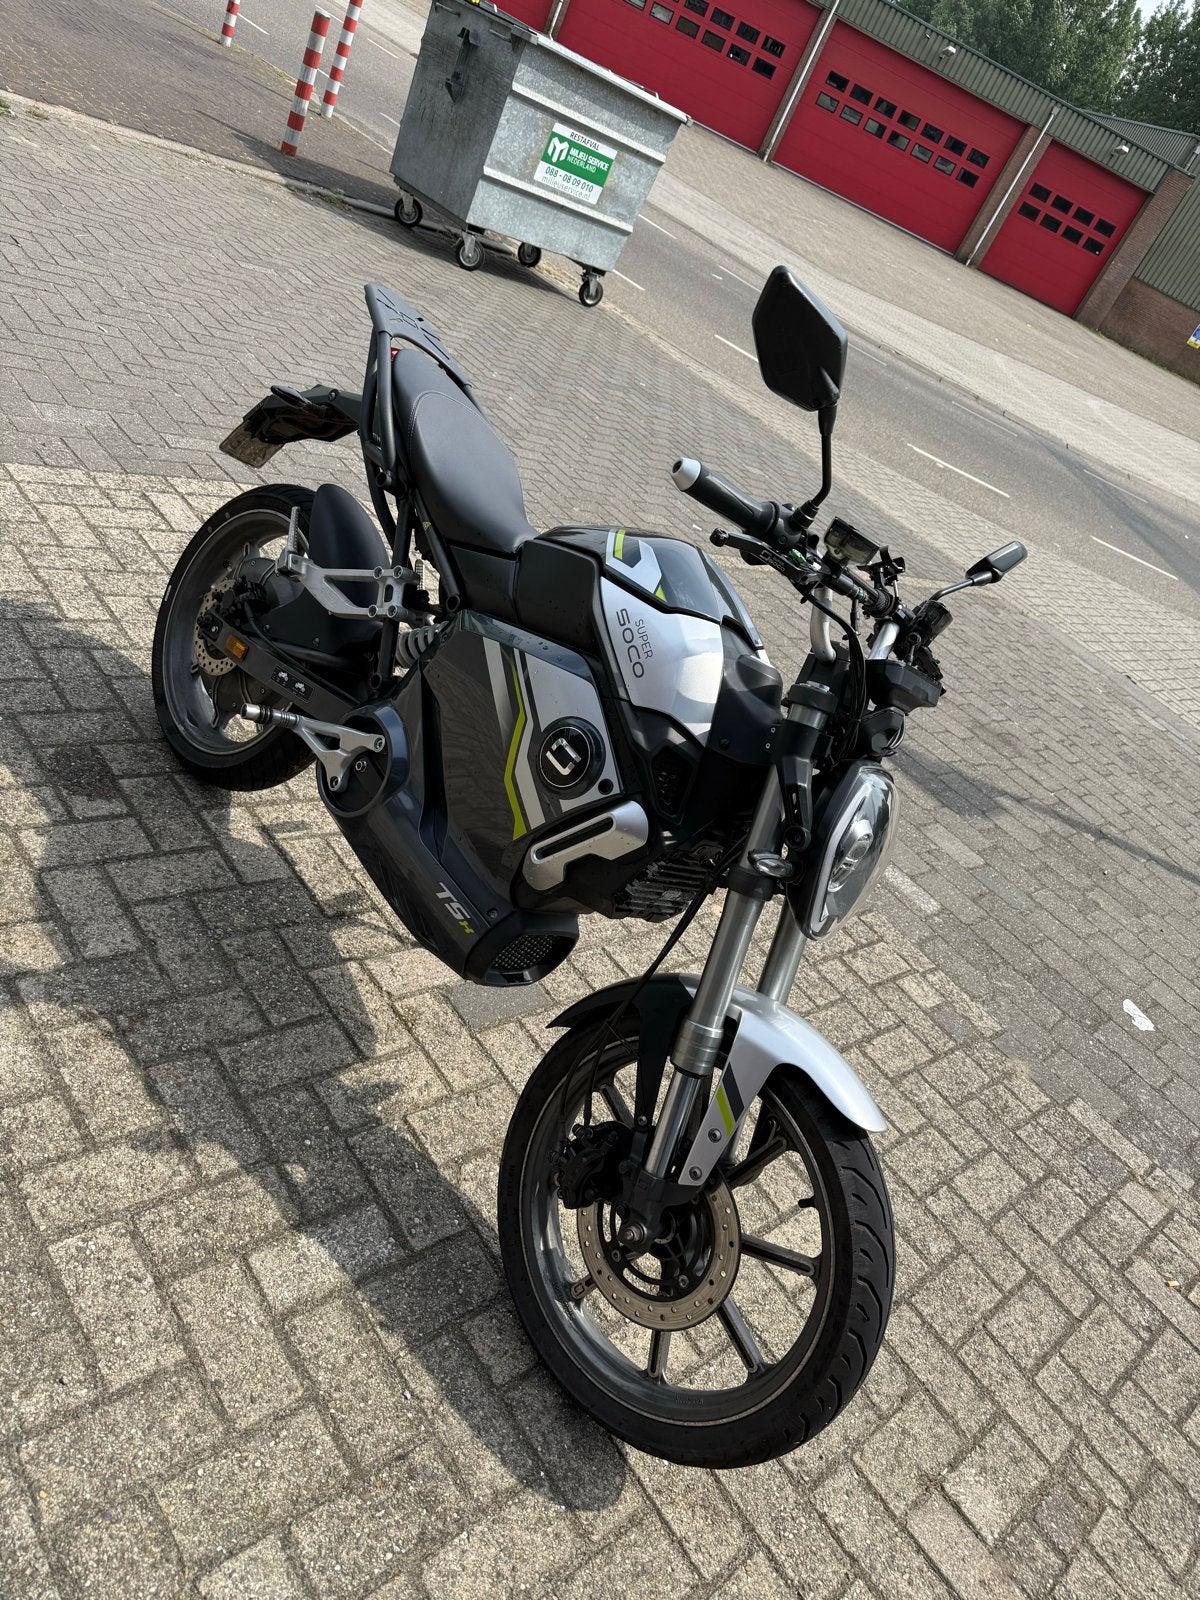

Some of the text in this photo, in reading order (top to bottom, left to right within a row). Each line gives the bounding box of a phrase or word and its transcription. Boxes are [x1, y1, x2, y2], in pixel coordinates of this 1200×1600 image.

[570, 131, 600, 151] RESTAFVAL
[566, 154, 597, 173] NEDERLAND
[569, 147, 609, 171] MILIEU SERVICE
[541, 176, 591, 200] milieuservice.nl
[545, 166, 559, 178] 088
[562, 173, 571, 184] 08
[572, 178, 581, 187] 09
[581, 182, 594, 193] 010
[616, 608, 645, 678] SOCO
[635, 618, 653, 660] SUPER
